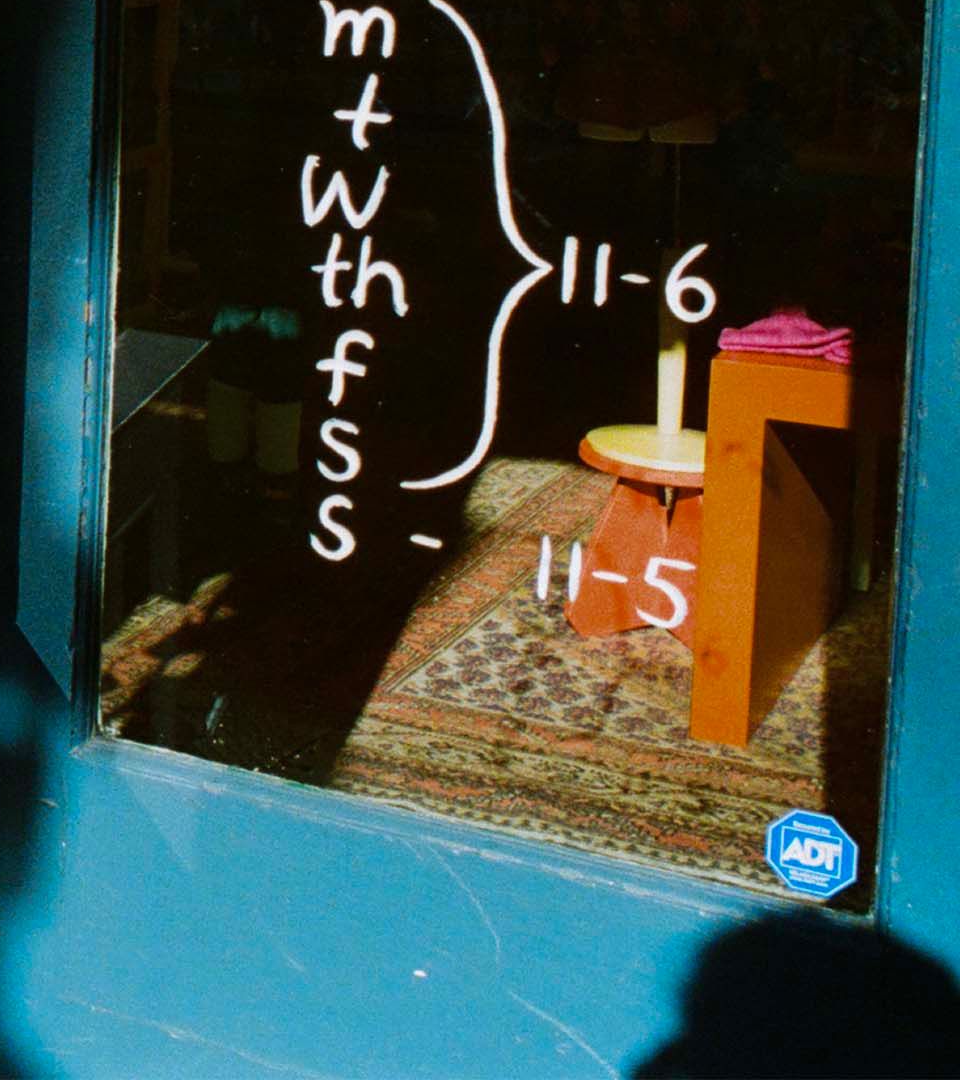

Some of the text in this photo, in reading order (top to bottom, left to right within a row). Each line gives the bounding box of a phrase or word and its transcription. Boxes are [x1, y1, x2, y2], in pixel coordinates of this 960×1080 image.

[311, 232, 409, 317] th
[560, 236, 717, 323] 11-6
[315, 329, 374, 407] f
[535, 535, 697, 629] 11-5
[782, 837, 841, 871] ADT
